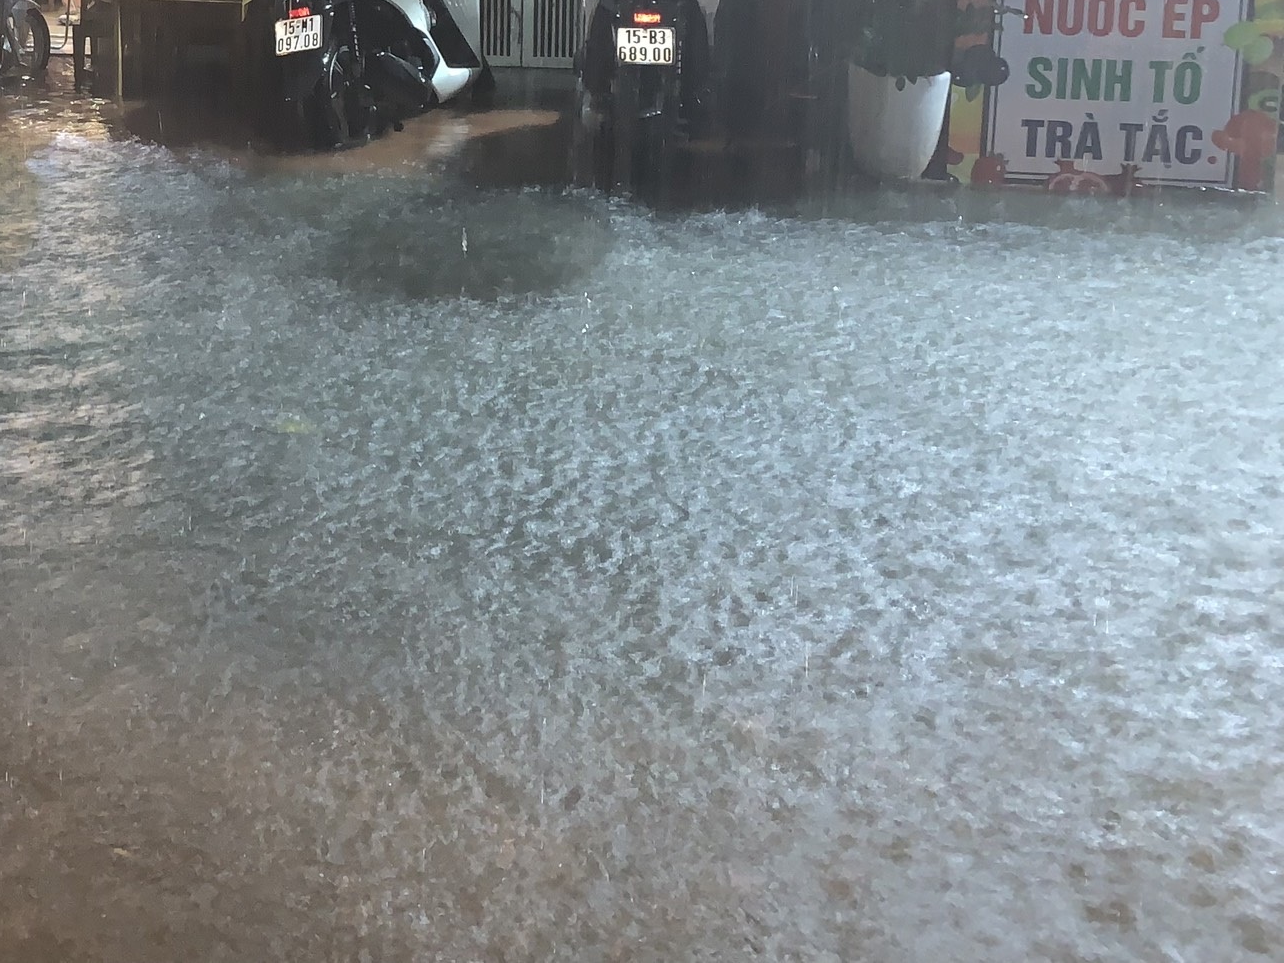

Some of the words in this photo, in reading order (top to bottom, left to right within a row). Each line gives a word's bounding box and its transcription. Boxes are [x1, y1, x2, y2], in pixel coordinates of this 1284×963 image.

[277, 32, 319, 52] 097.08
[625, 29, 666, 45] 15-B3
[618, 45, 672, 63] 689.00
[1024, 56, 1133, 102] SINH
[1149, 46, 1204, 105] TỐ
[1020, 112, 1103, 161] TRÀ
[1119, 109, 1203, 166] TẮC
